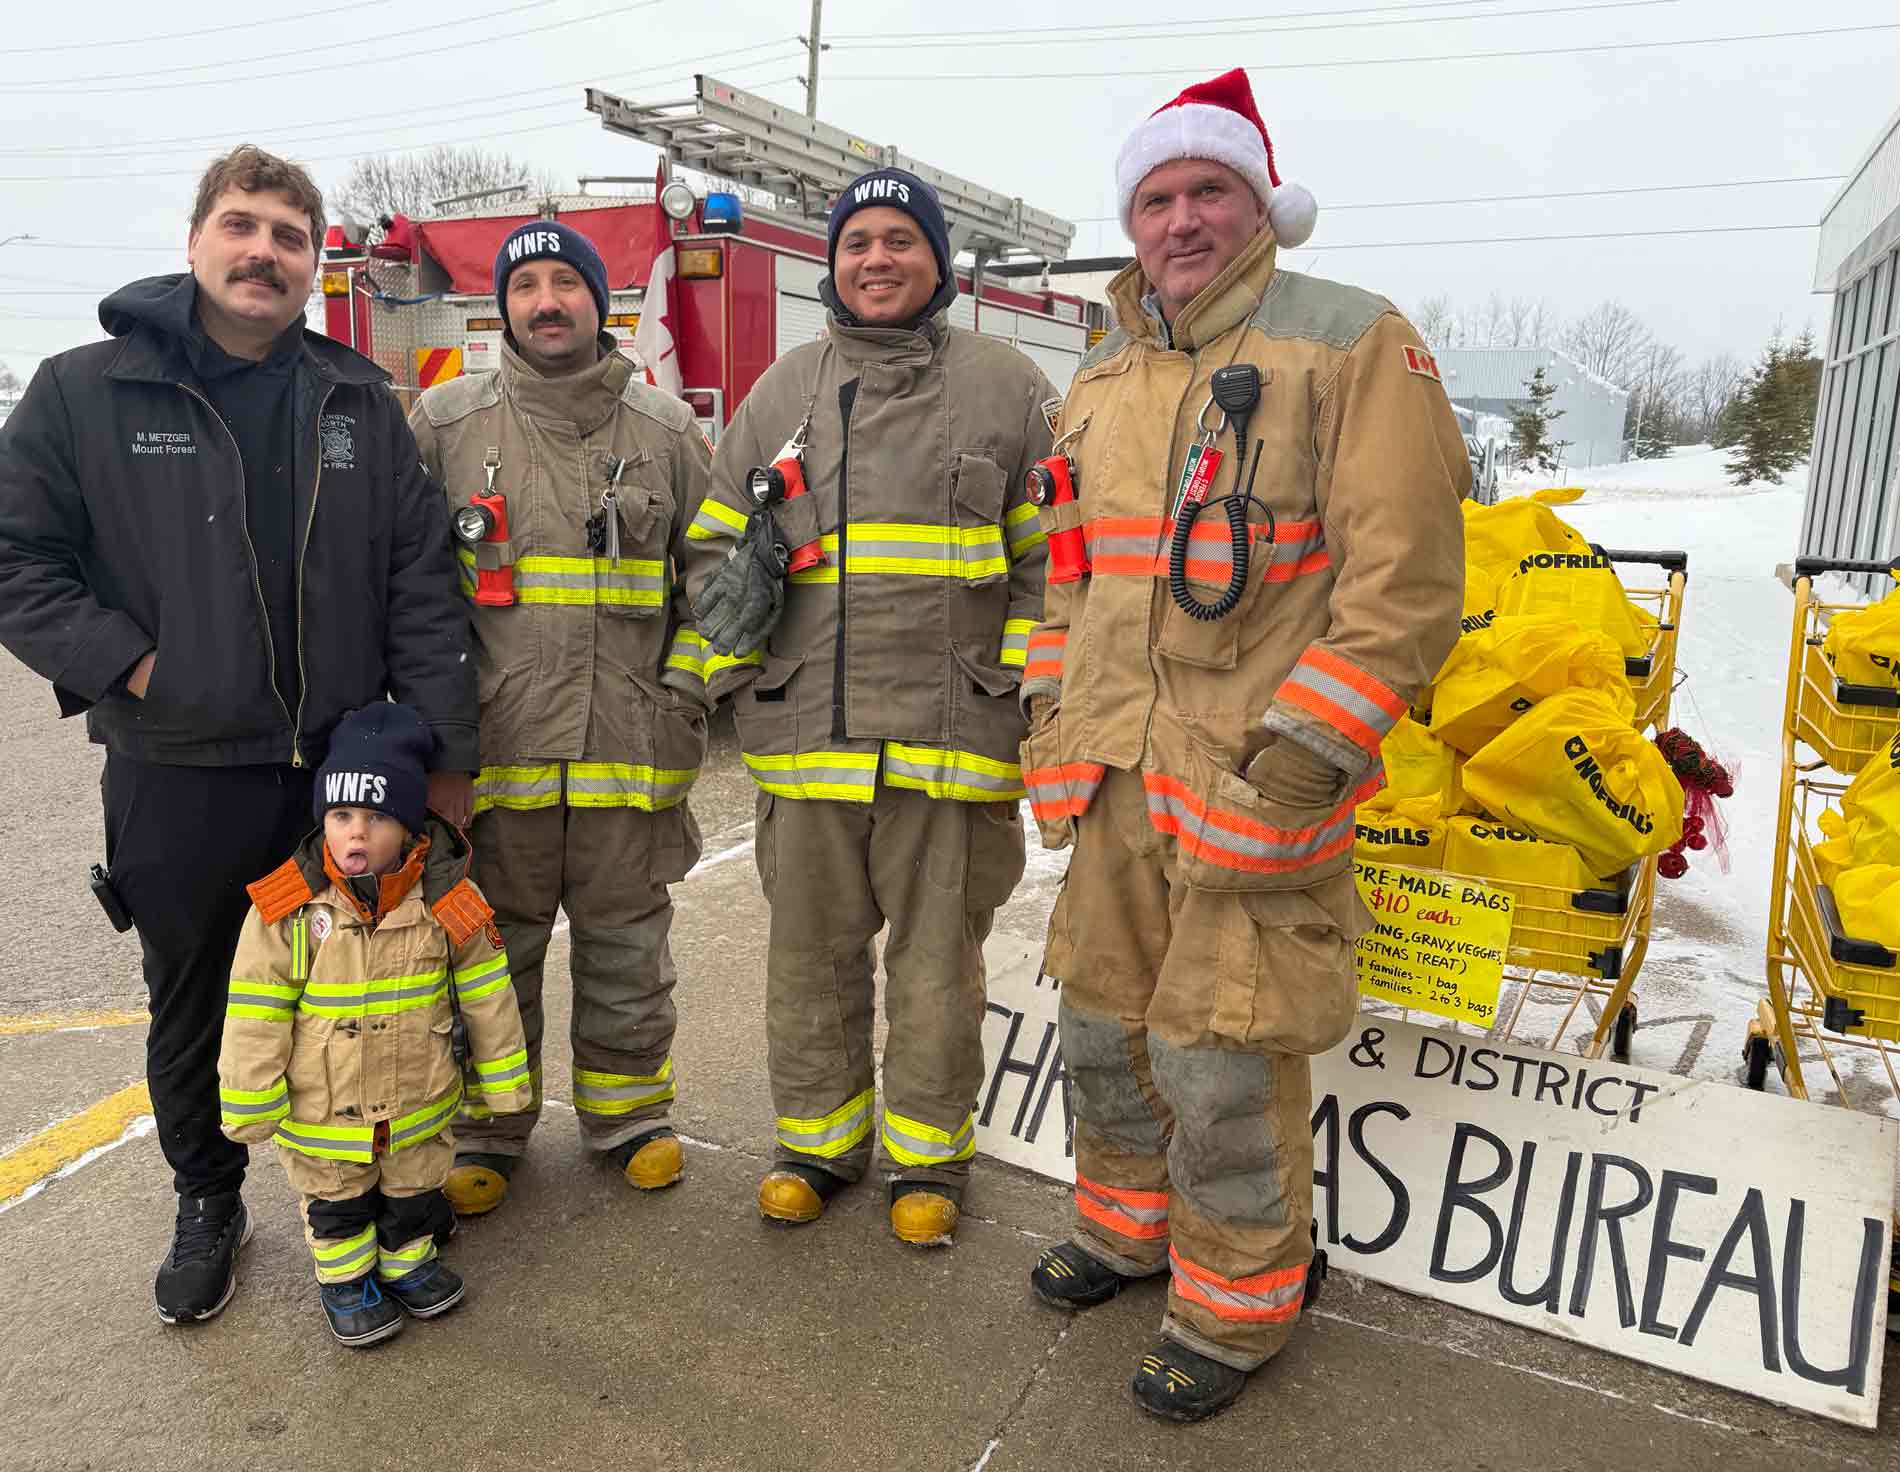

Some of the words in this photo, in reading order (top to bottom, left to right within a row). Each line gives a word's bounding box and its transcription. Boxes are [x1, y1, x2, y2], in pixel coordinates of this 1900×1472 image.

[855, 179, 910, 203] WNFS
[508, 231, 560, 262] WNFS
[132, 443, 164, 454] Mount
[166, 445, 197, 454] Forest
[136, 431, 147, 441] M.
[149, 431, 191, 442] METZGER
[1519, 553, 1615, 575] NOFRILL
[326, 772, 387, 804] WNFS
[1574, 756, 1653, 835] NOFRILLS
[1369, 887, 1410, 913] $10
[1417, 909, 1461, 926] each
[1461, 887, 1510, 912] BAGS
[1369, 959, 1413, 981] families
[1436, 976, 1458, 996] bag
[1416, 951, 1467, 976] TREAT)
[1369, 974, 1413, 995] families
[1429, 990, 1438, 1001] 2
[1439, 994, 1450, 1005] to
[1454, 996, 1462, 1008] 3
[1467, 999, 1494, 1018] bags
[1350, 1027, 1386, 1069] &
[1414, 1036, 1658, 1123] DISTRICT
[1429, 1122, 1885, 1397] BUREAU
